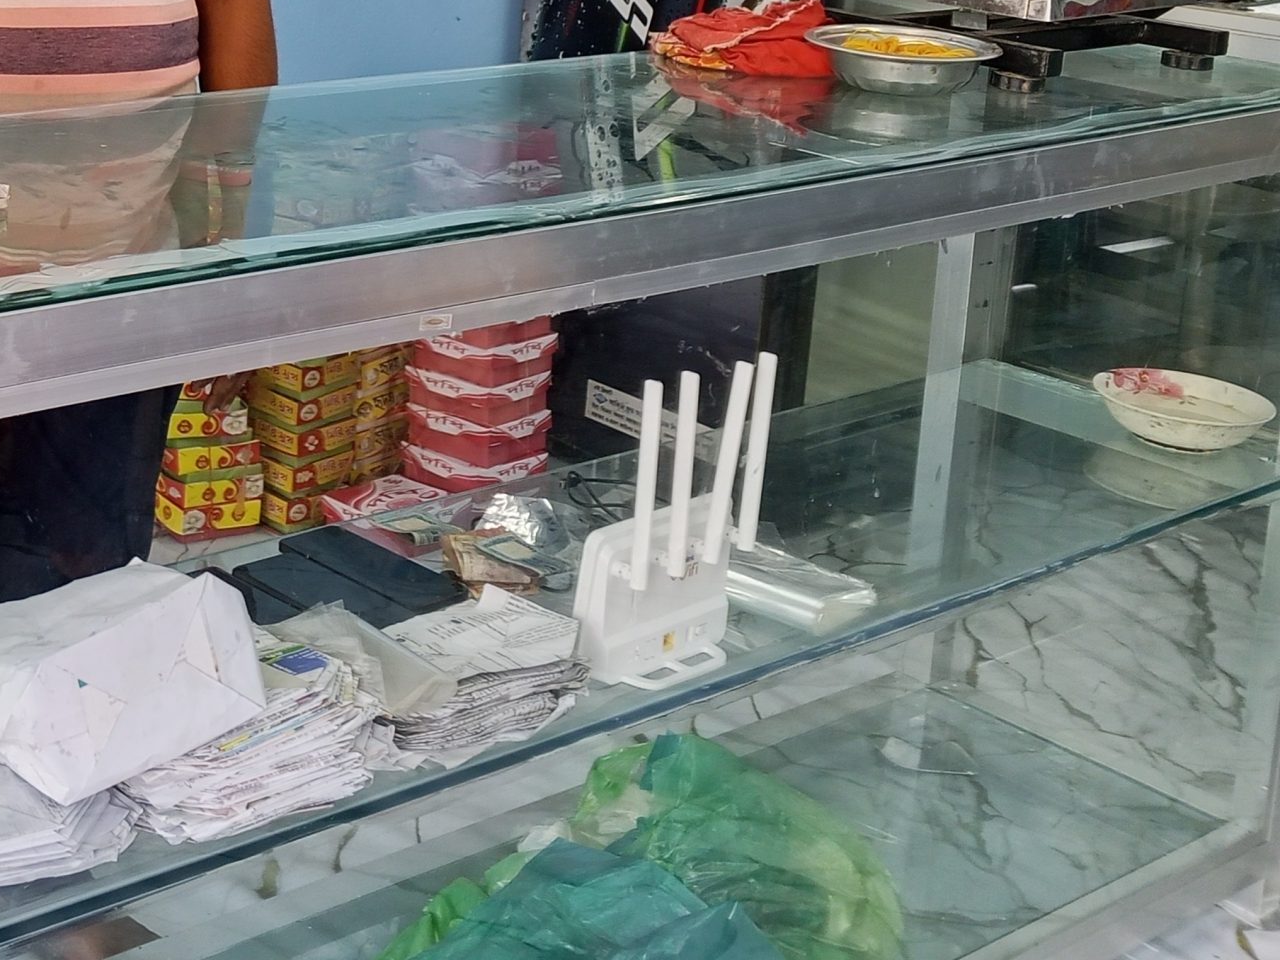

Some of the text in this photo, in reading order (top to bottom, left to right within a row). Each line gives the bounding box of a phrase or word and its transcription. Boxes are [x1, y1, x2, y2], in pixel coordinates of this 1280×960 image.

[510, 341, 542, 355] দধি
[425, 376, 464, 393] দধি
[506, 379, 536, 394] দধি
[426, 411, 465, 430] দধি
[507, 418, 537, 432] দধি
[420, 452, 456, 474] দধি
[497, 462, 532, 477] দধি
